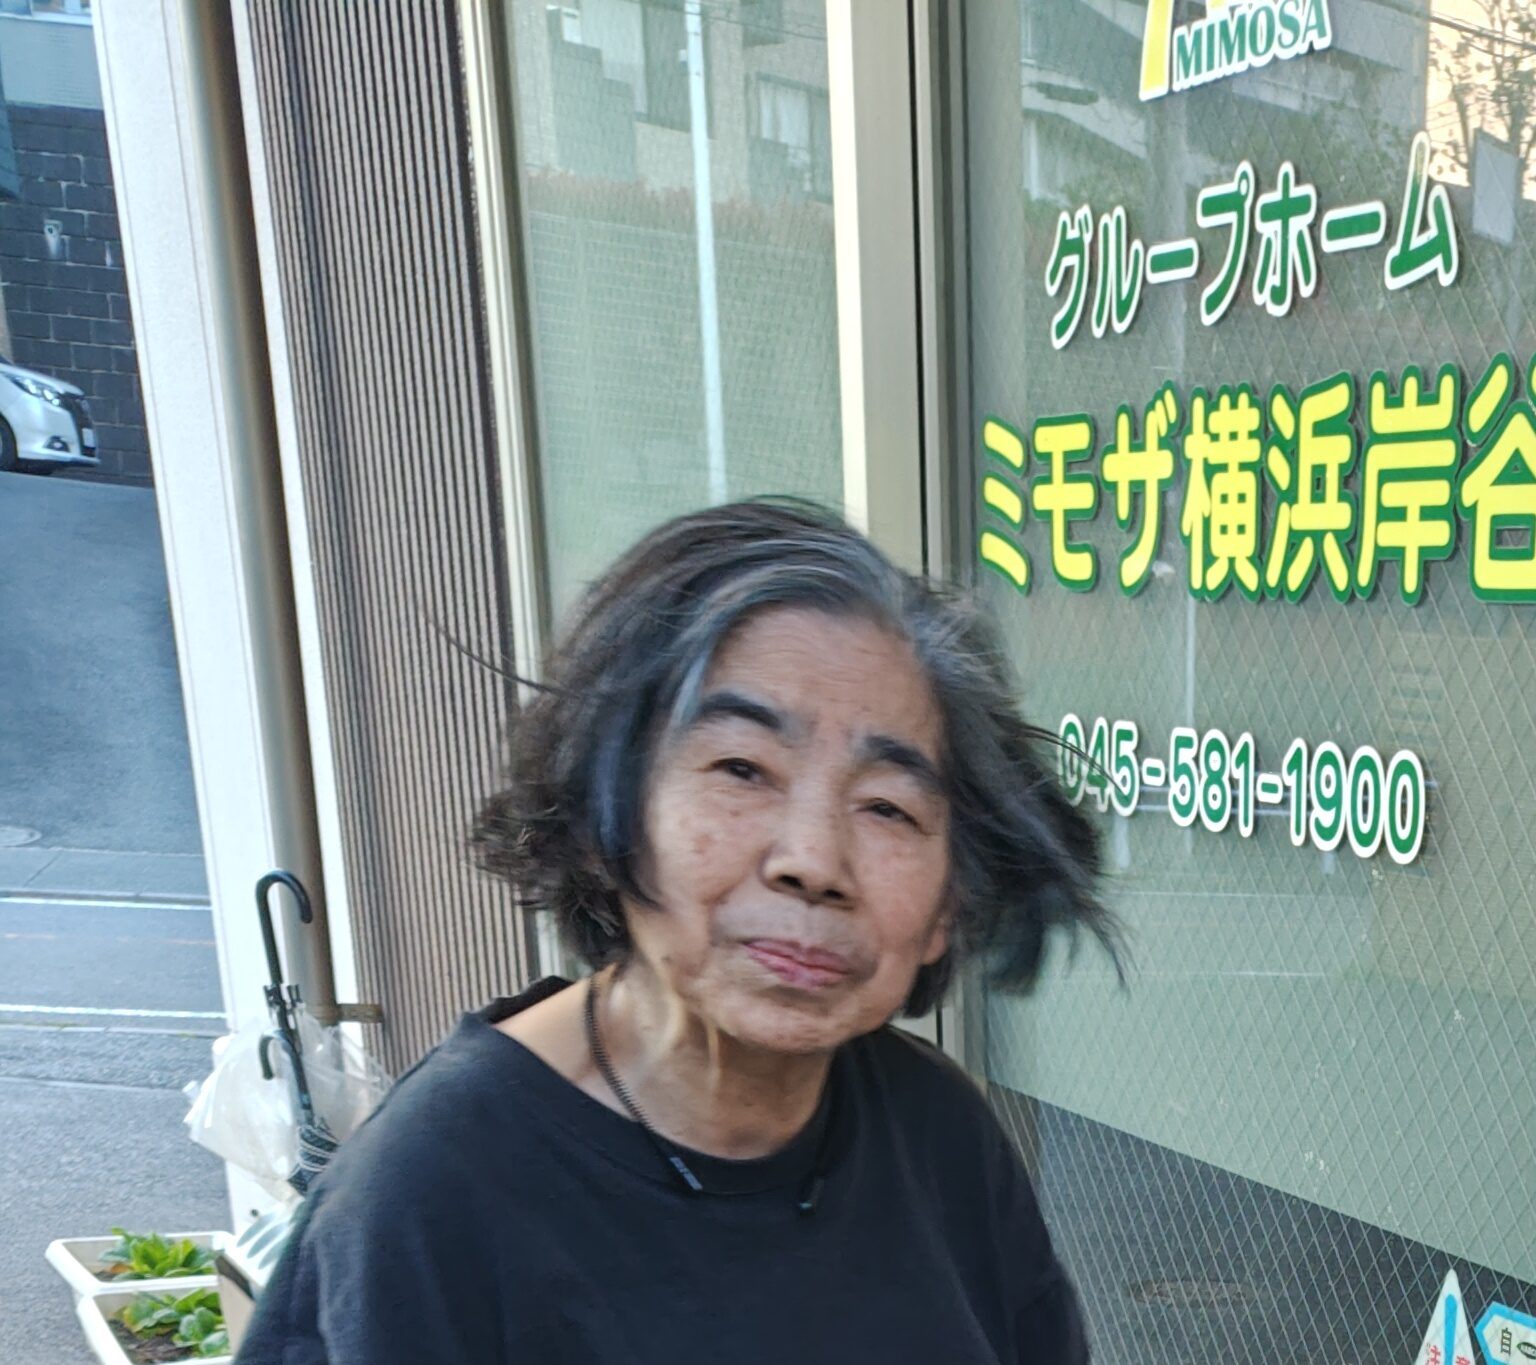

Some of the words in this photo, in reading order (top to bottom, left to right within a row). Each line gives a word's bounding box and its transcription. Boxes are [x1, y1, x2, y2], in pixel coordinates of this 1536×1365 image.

[1174, 0, 1329, 84] MIMOSA
[1047, 134, 1457, 347] グループホーム
[1060, 716, 1424, 863] 045-581-1900
